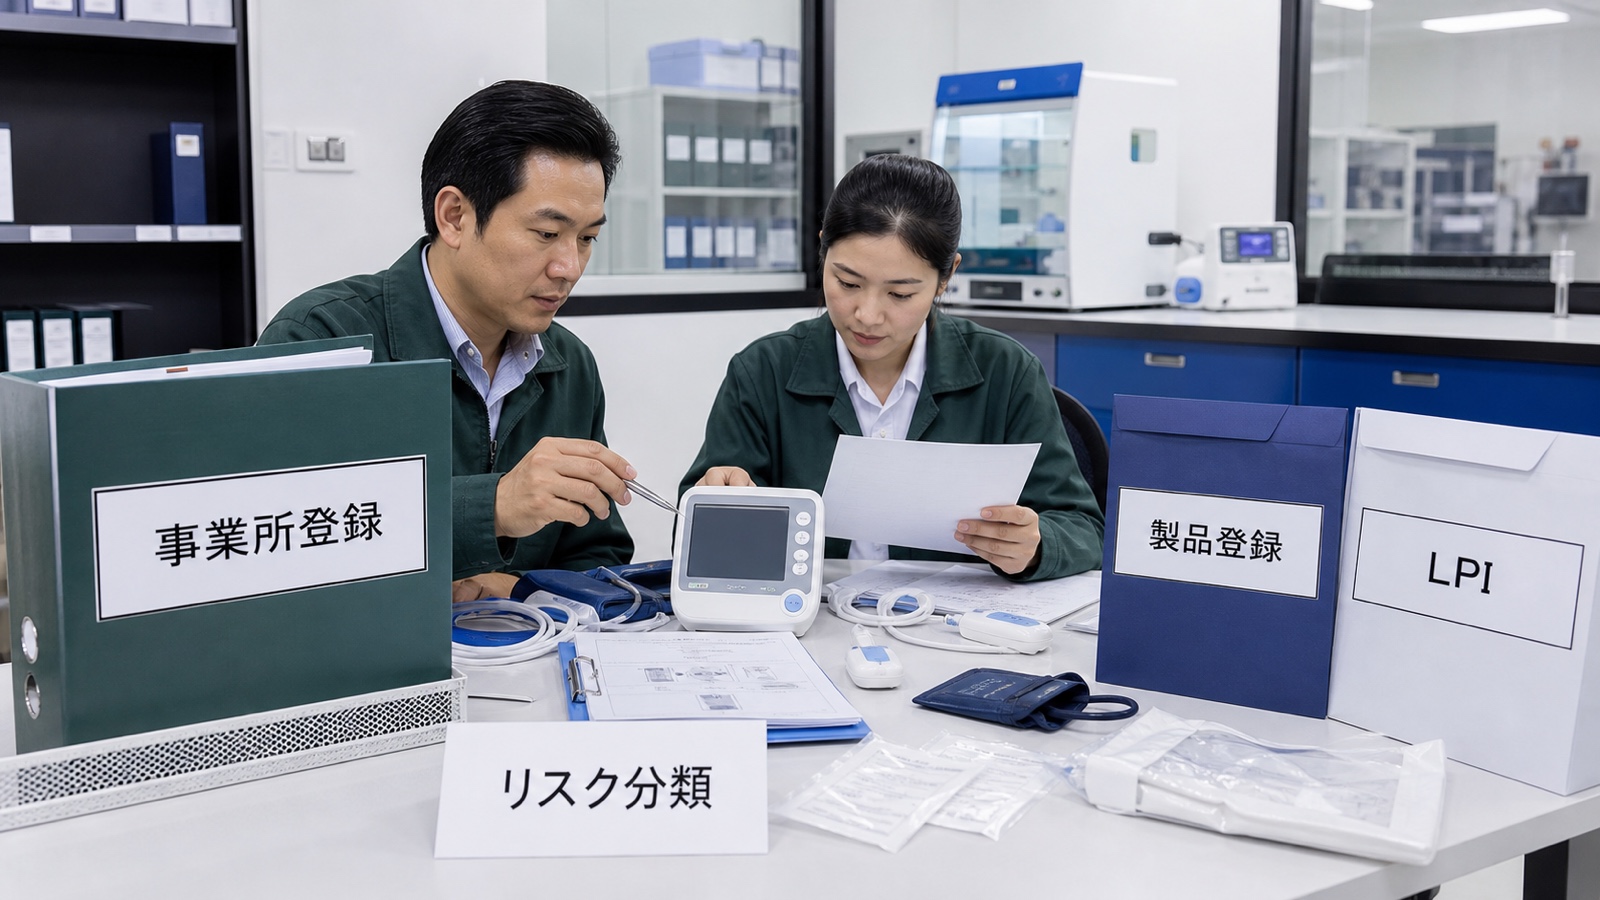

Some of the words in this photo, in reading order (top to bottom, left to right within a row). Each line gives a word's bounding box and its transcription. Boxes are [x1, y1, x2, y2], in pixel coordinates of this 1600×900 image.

[155, 501, 383, 567] 事業所登録
[1149, 519, 1282, 562] 製品登録
[1428, 551, 1493, 594] LPI
[504, 765, 712, 809] リスク分類
